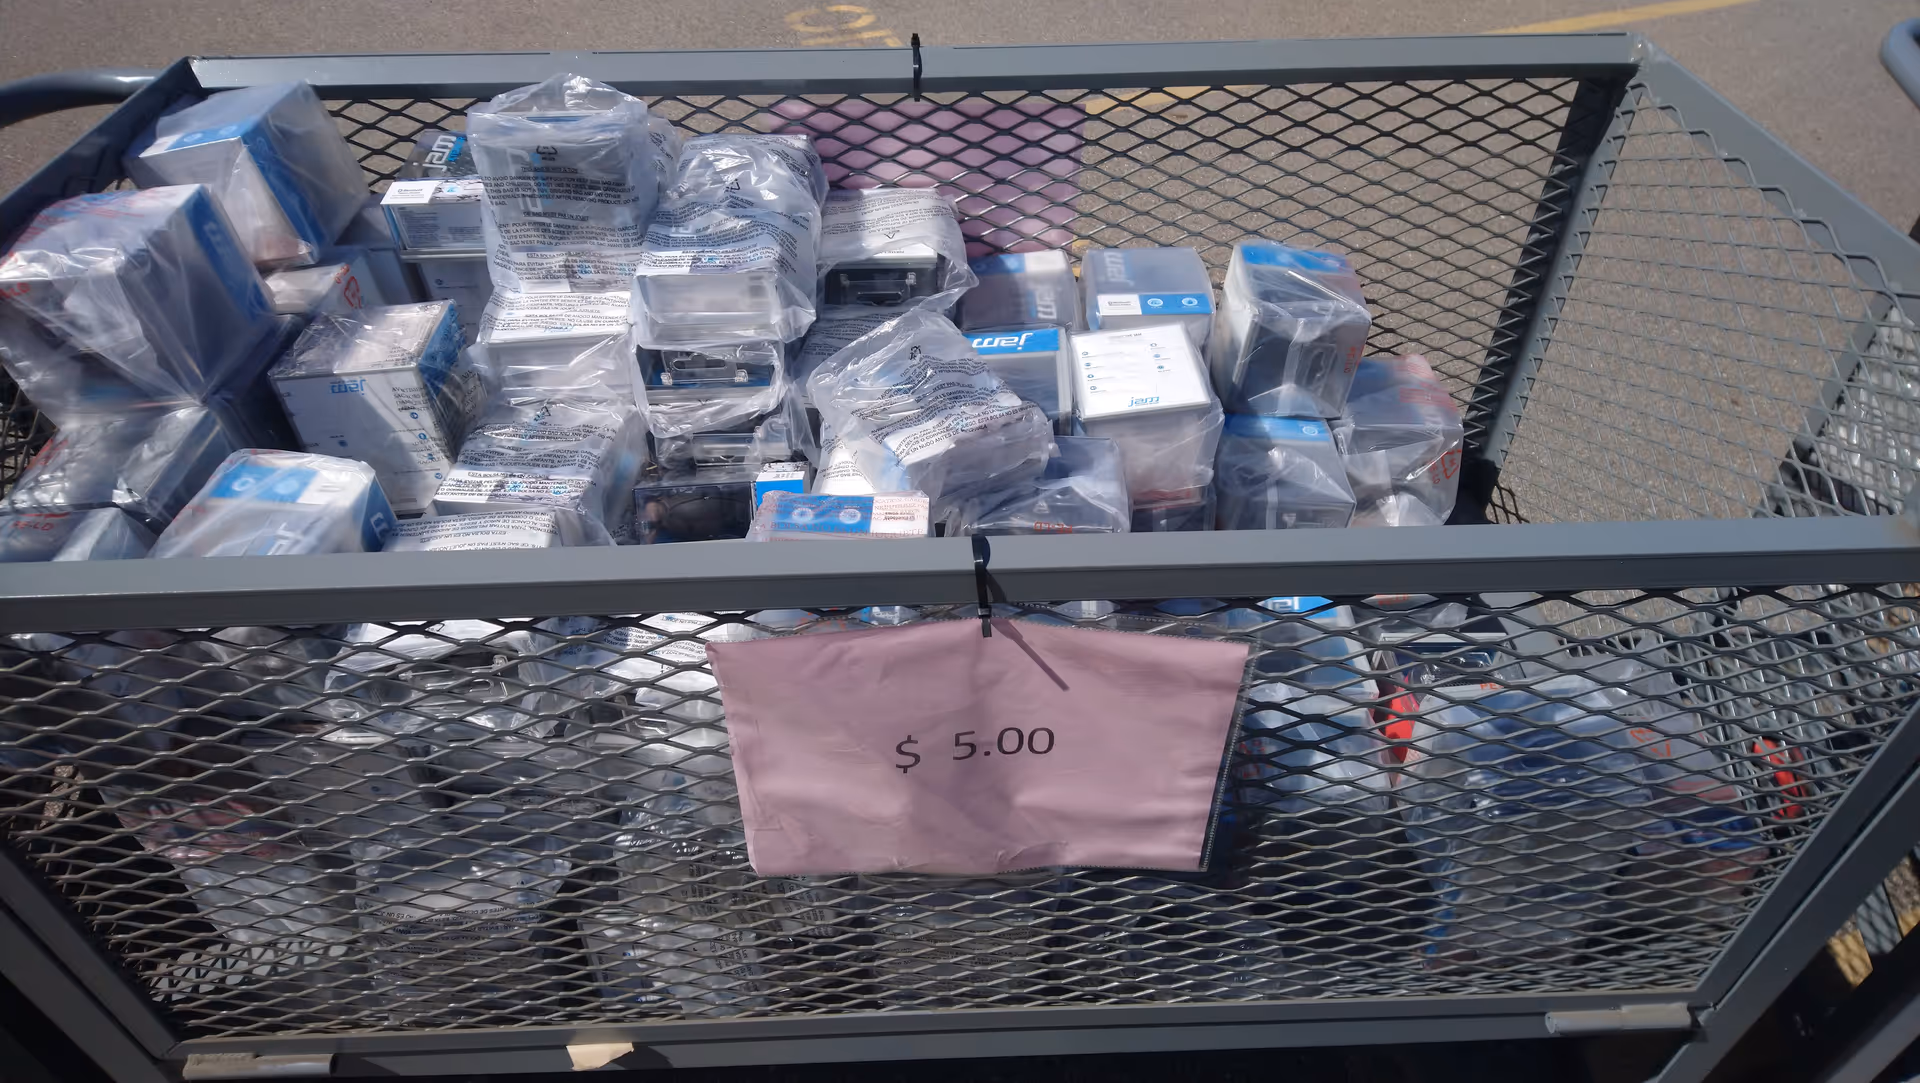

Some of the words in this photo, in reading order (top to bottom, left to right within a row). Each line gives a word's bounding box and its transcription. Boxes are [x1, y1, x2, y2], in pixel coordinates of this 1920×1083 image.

[412, 135, 456, 172] jam
[972, 332, 1034, 350] jam
[330, 378, 366, 396] jam
[1128, 396, 1160, 407] jam
[895, 734, 921, 774] $
[952, 727, 1055, 761] 5.00
